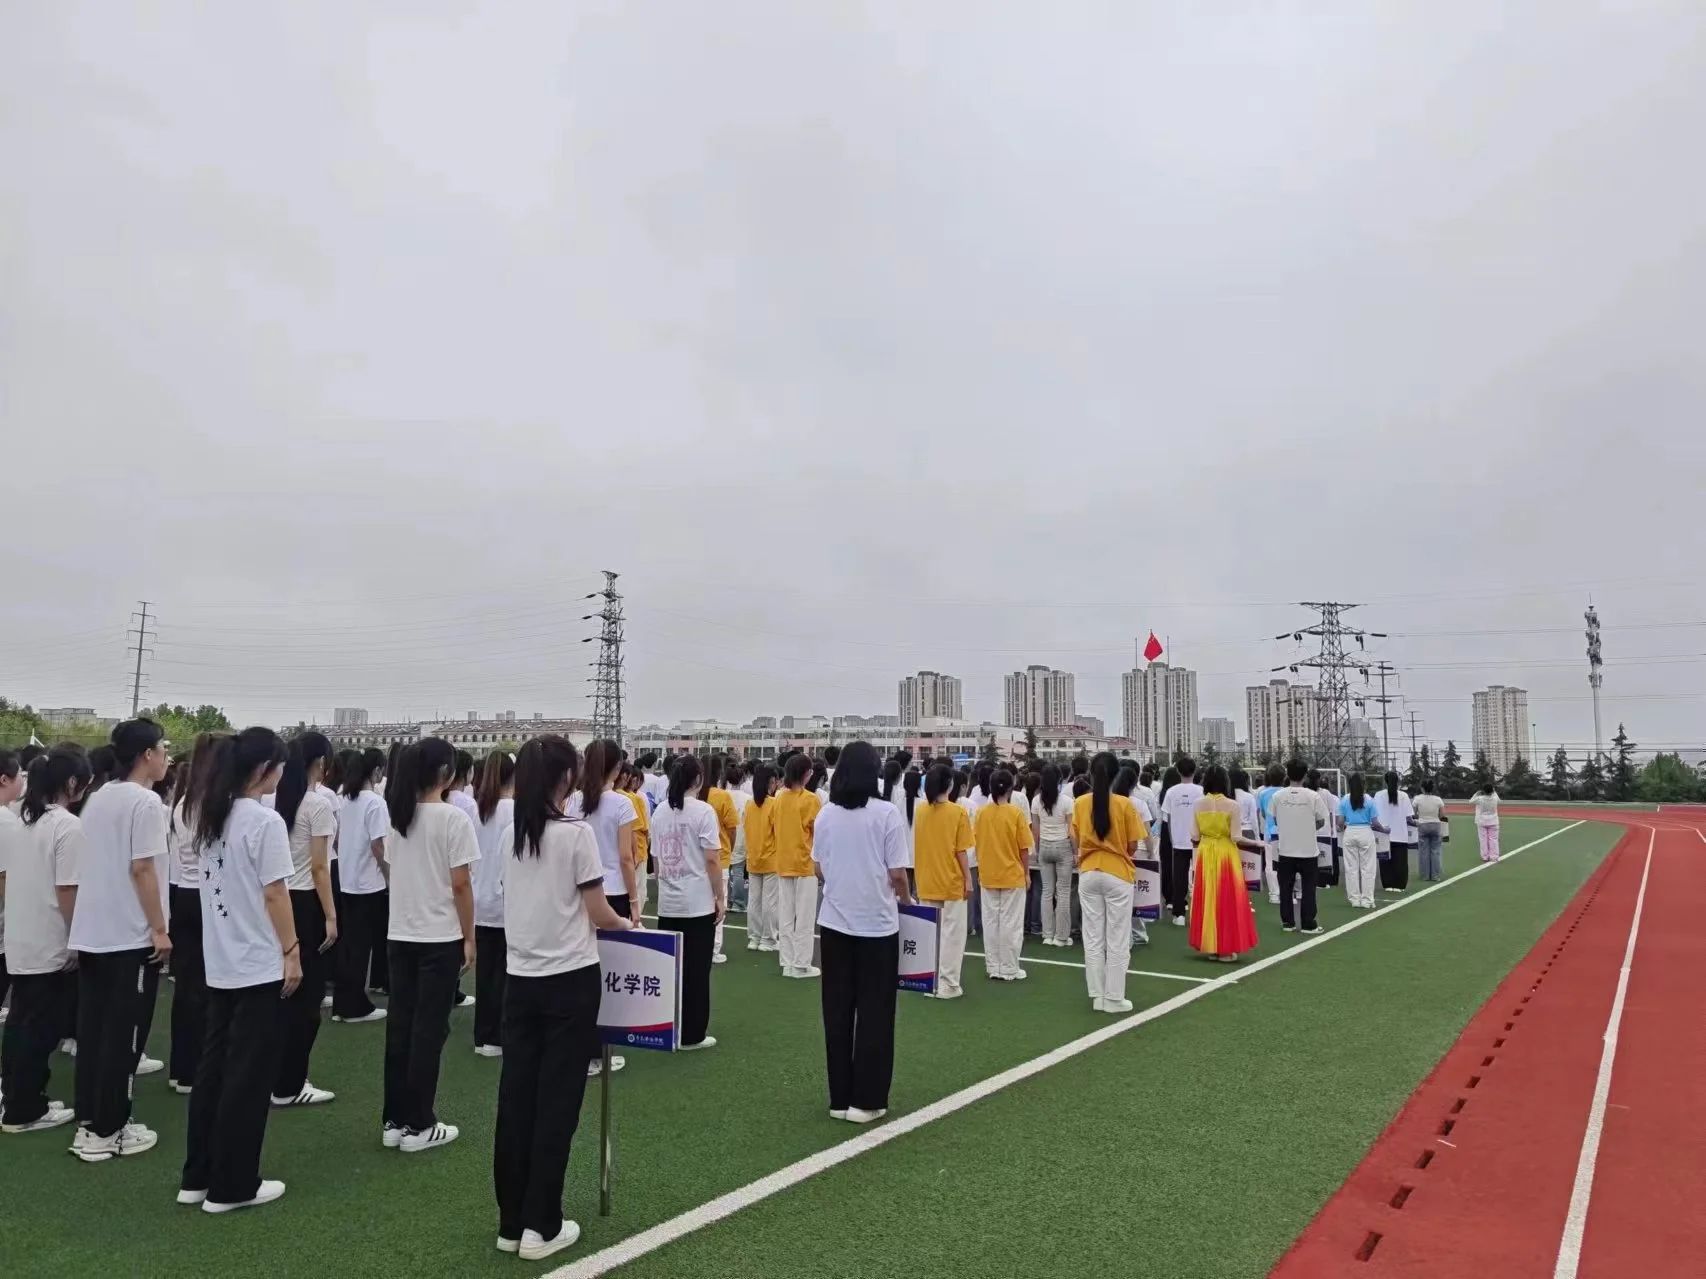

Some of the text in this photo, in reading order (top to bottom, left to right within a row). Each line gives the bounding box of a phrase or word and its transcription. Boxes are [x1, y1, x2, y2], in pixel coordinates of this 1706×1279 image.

[903, 939, 917, 956] 院
[604, 971, 662, 998] 化学院
